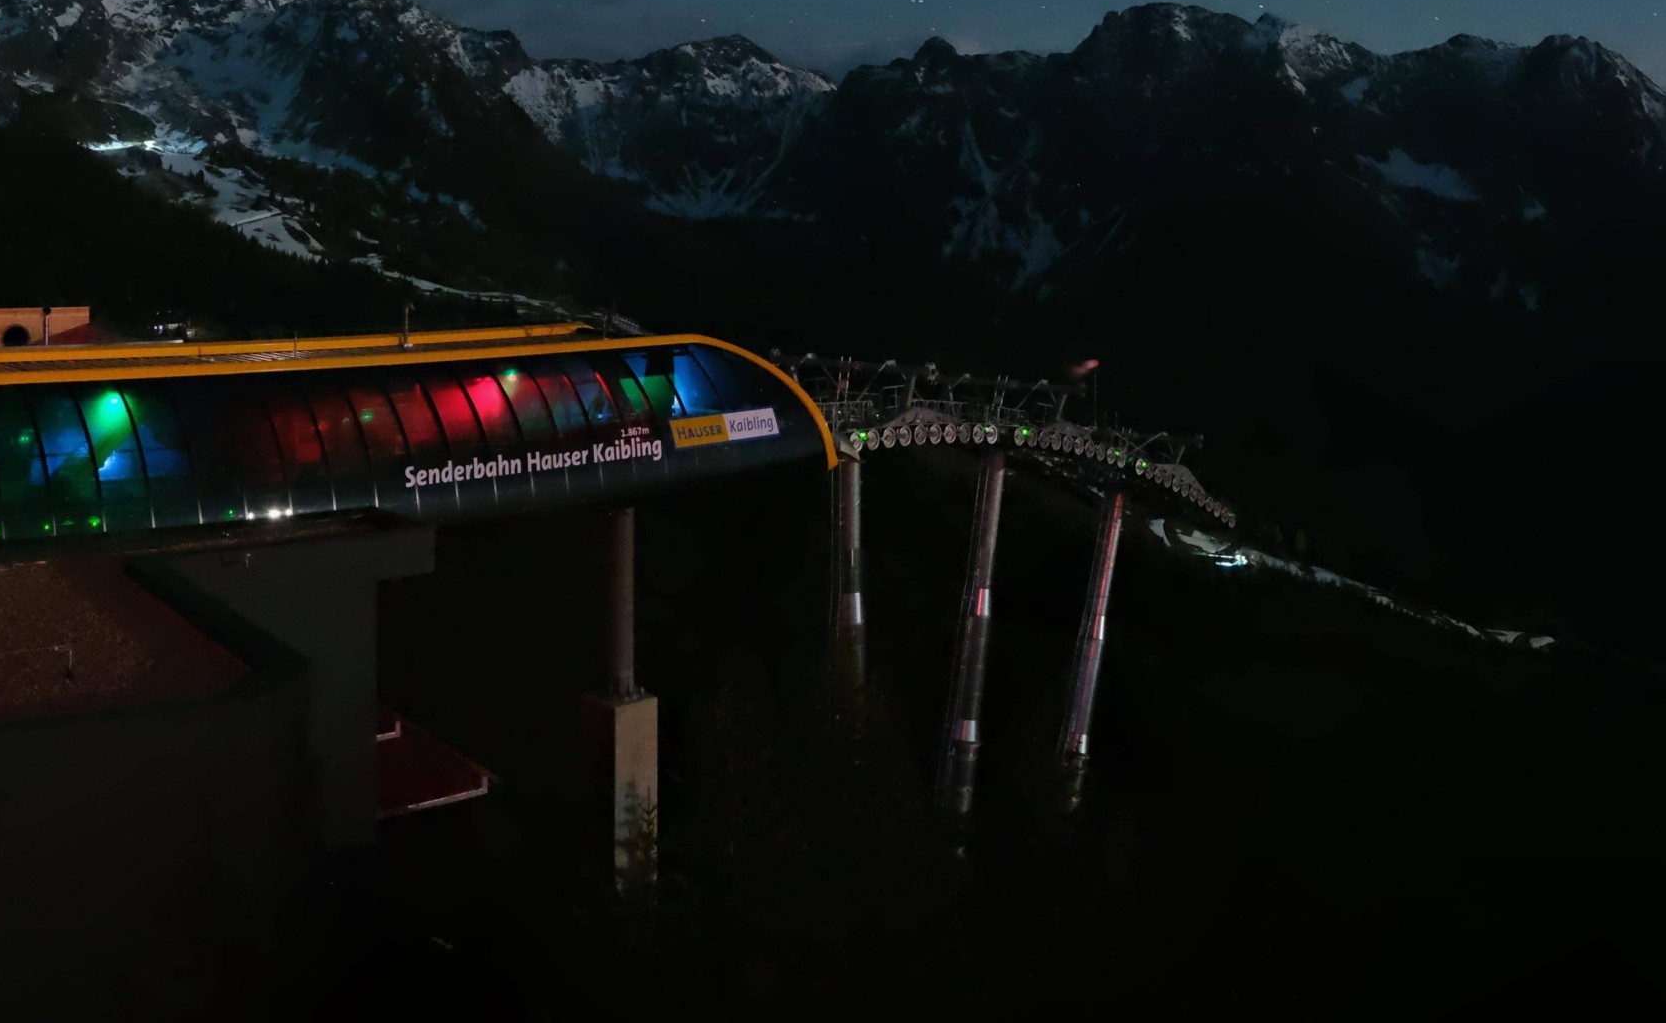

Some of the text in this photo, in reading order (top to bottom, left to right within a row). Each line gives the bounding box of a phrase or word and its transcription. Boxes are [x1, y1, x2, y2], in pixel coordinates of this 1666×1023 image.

[620, 426, 650, 438] 1.867m
[676, 415, 774, 441] HAUSER Kaibling
[405, 437, 662, 488] Senderbahn Hauser Kaibling
